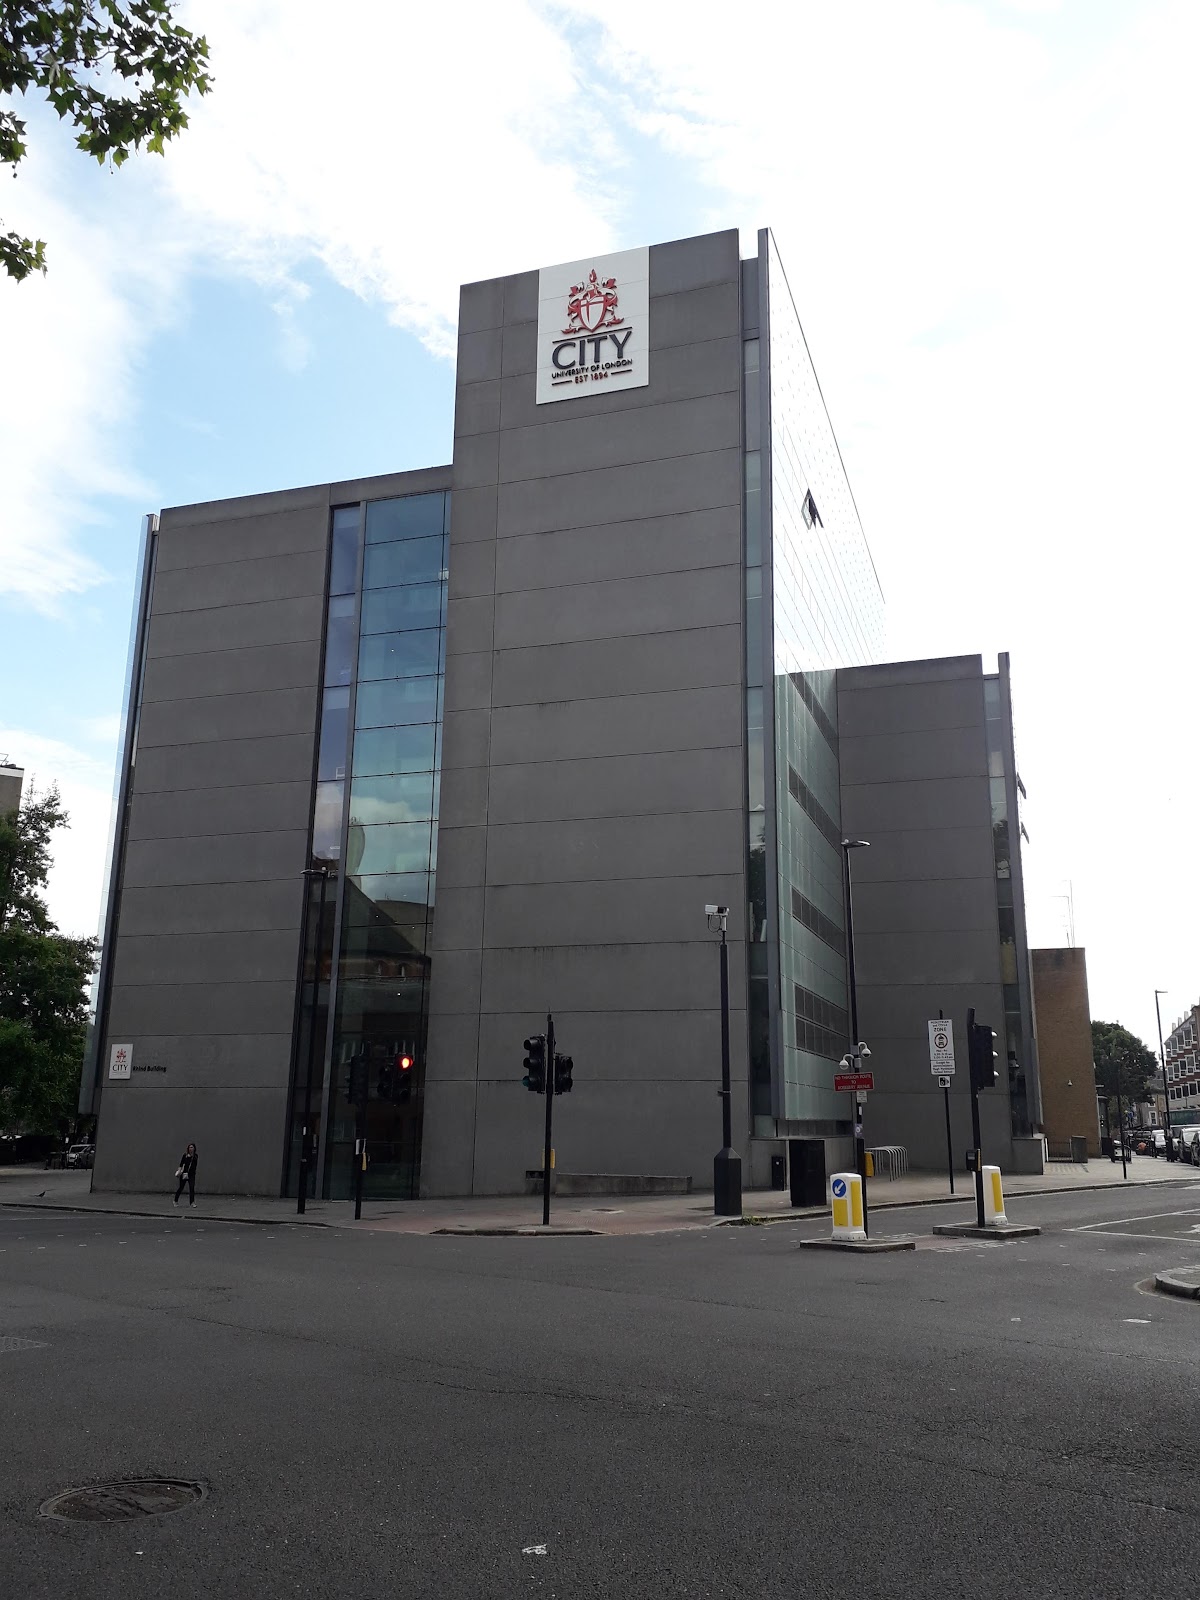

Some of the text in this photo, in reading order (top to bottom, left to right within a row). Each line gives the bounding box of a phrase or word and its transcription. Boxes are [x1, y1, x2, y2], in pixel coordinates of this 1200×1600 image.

[552, 330, 632, 369] CITY
[552, 366, 589, 378] UNIVERSITY
[602, 359, 632, 370] LONDON
[575, 371, 608, 384] EST 1894
[147, 1065, 167, 1073] Building
